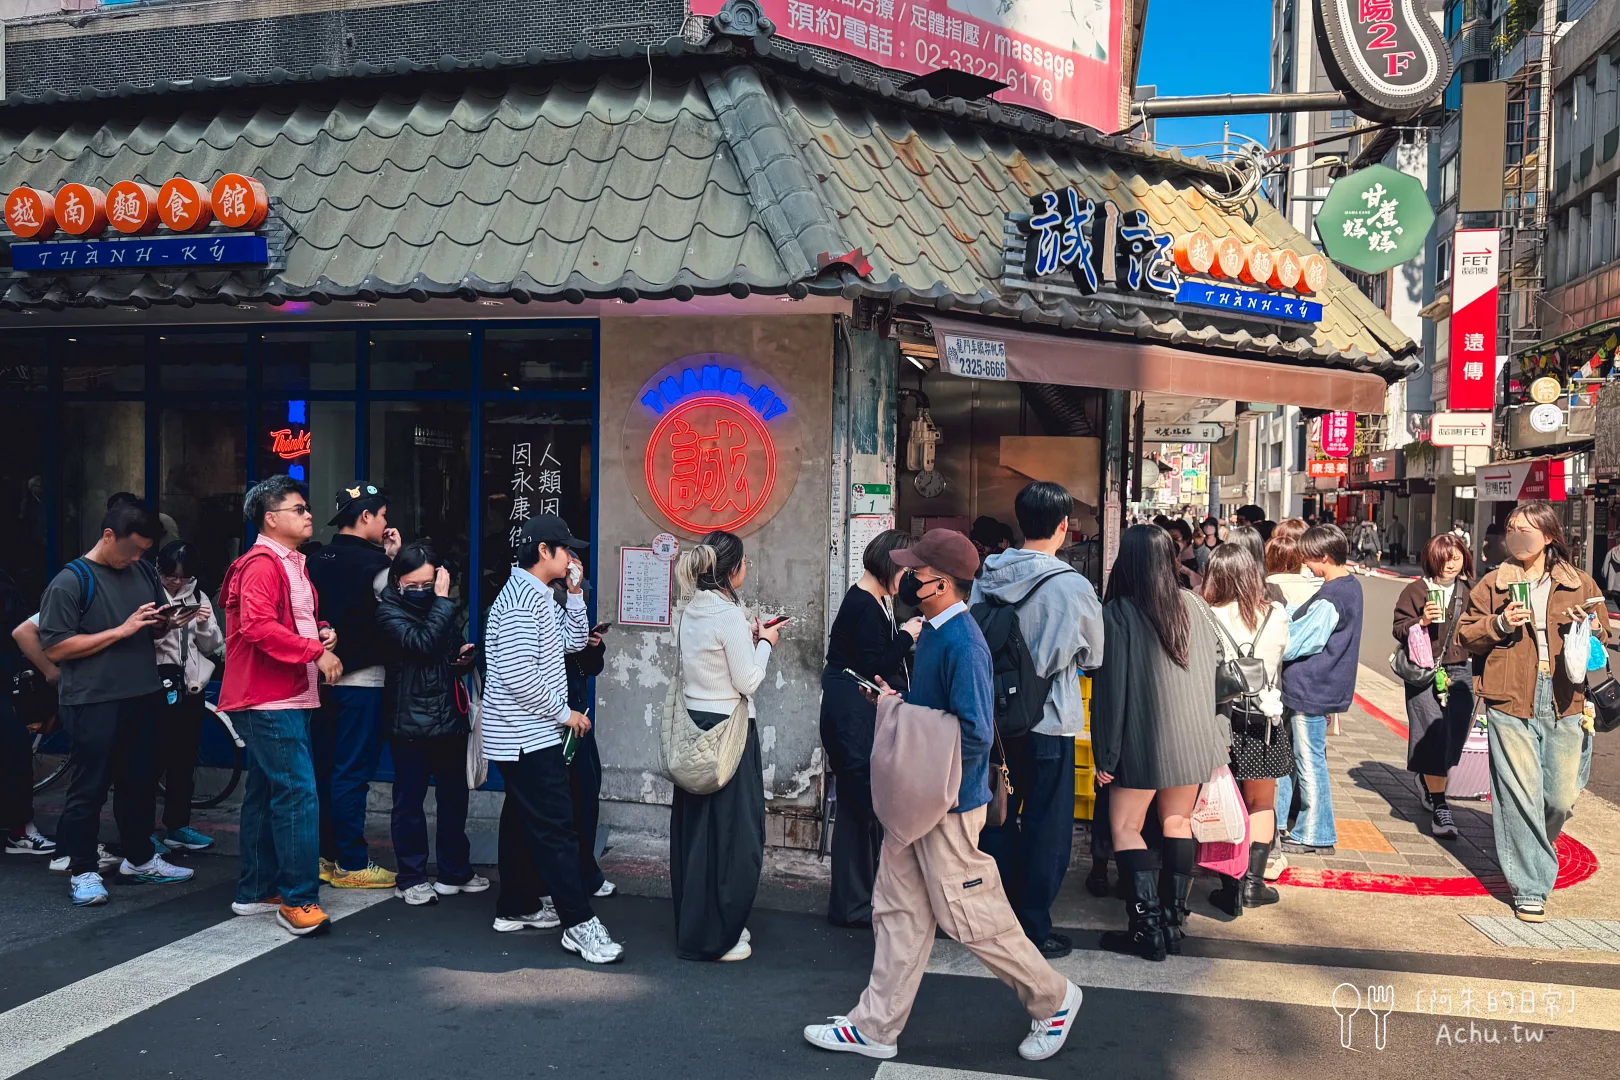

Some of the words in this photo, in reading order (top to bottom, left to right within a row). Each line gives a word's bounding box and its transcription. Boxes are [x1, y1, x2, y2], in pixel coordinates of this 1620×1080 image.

[910, 5, 980, 48] 足體指壓
[994, 33, 1075, 79] massage
[915, 38, 1054, 102] 02-3322-6178
[10, 184, 248, 228] 越南麵食館
[1190, 234, 1325, 285] 越南麵食館
[1461, 255, 1492, 266] FET
[959, 357, 1006, 378] 2325-6666
[1463, 332, 1485, 381] 遠傳
[668, 419, 750, 513] 誠
[1311, 463, 1348, 474] 康是美
[869, 499, 875, 513] 1
